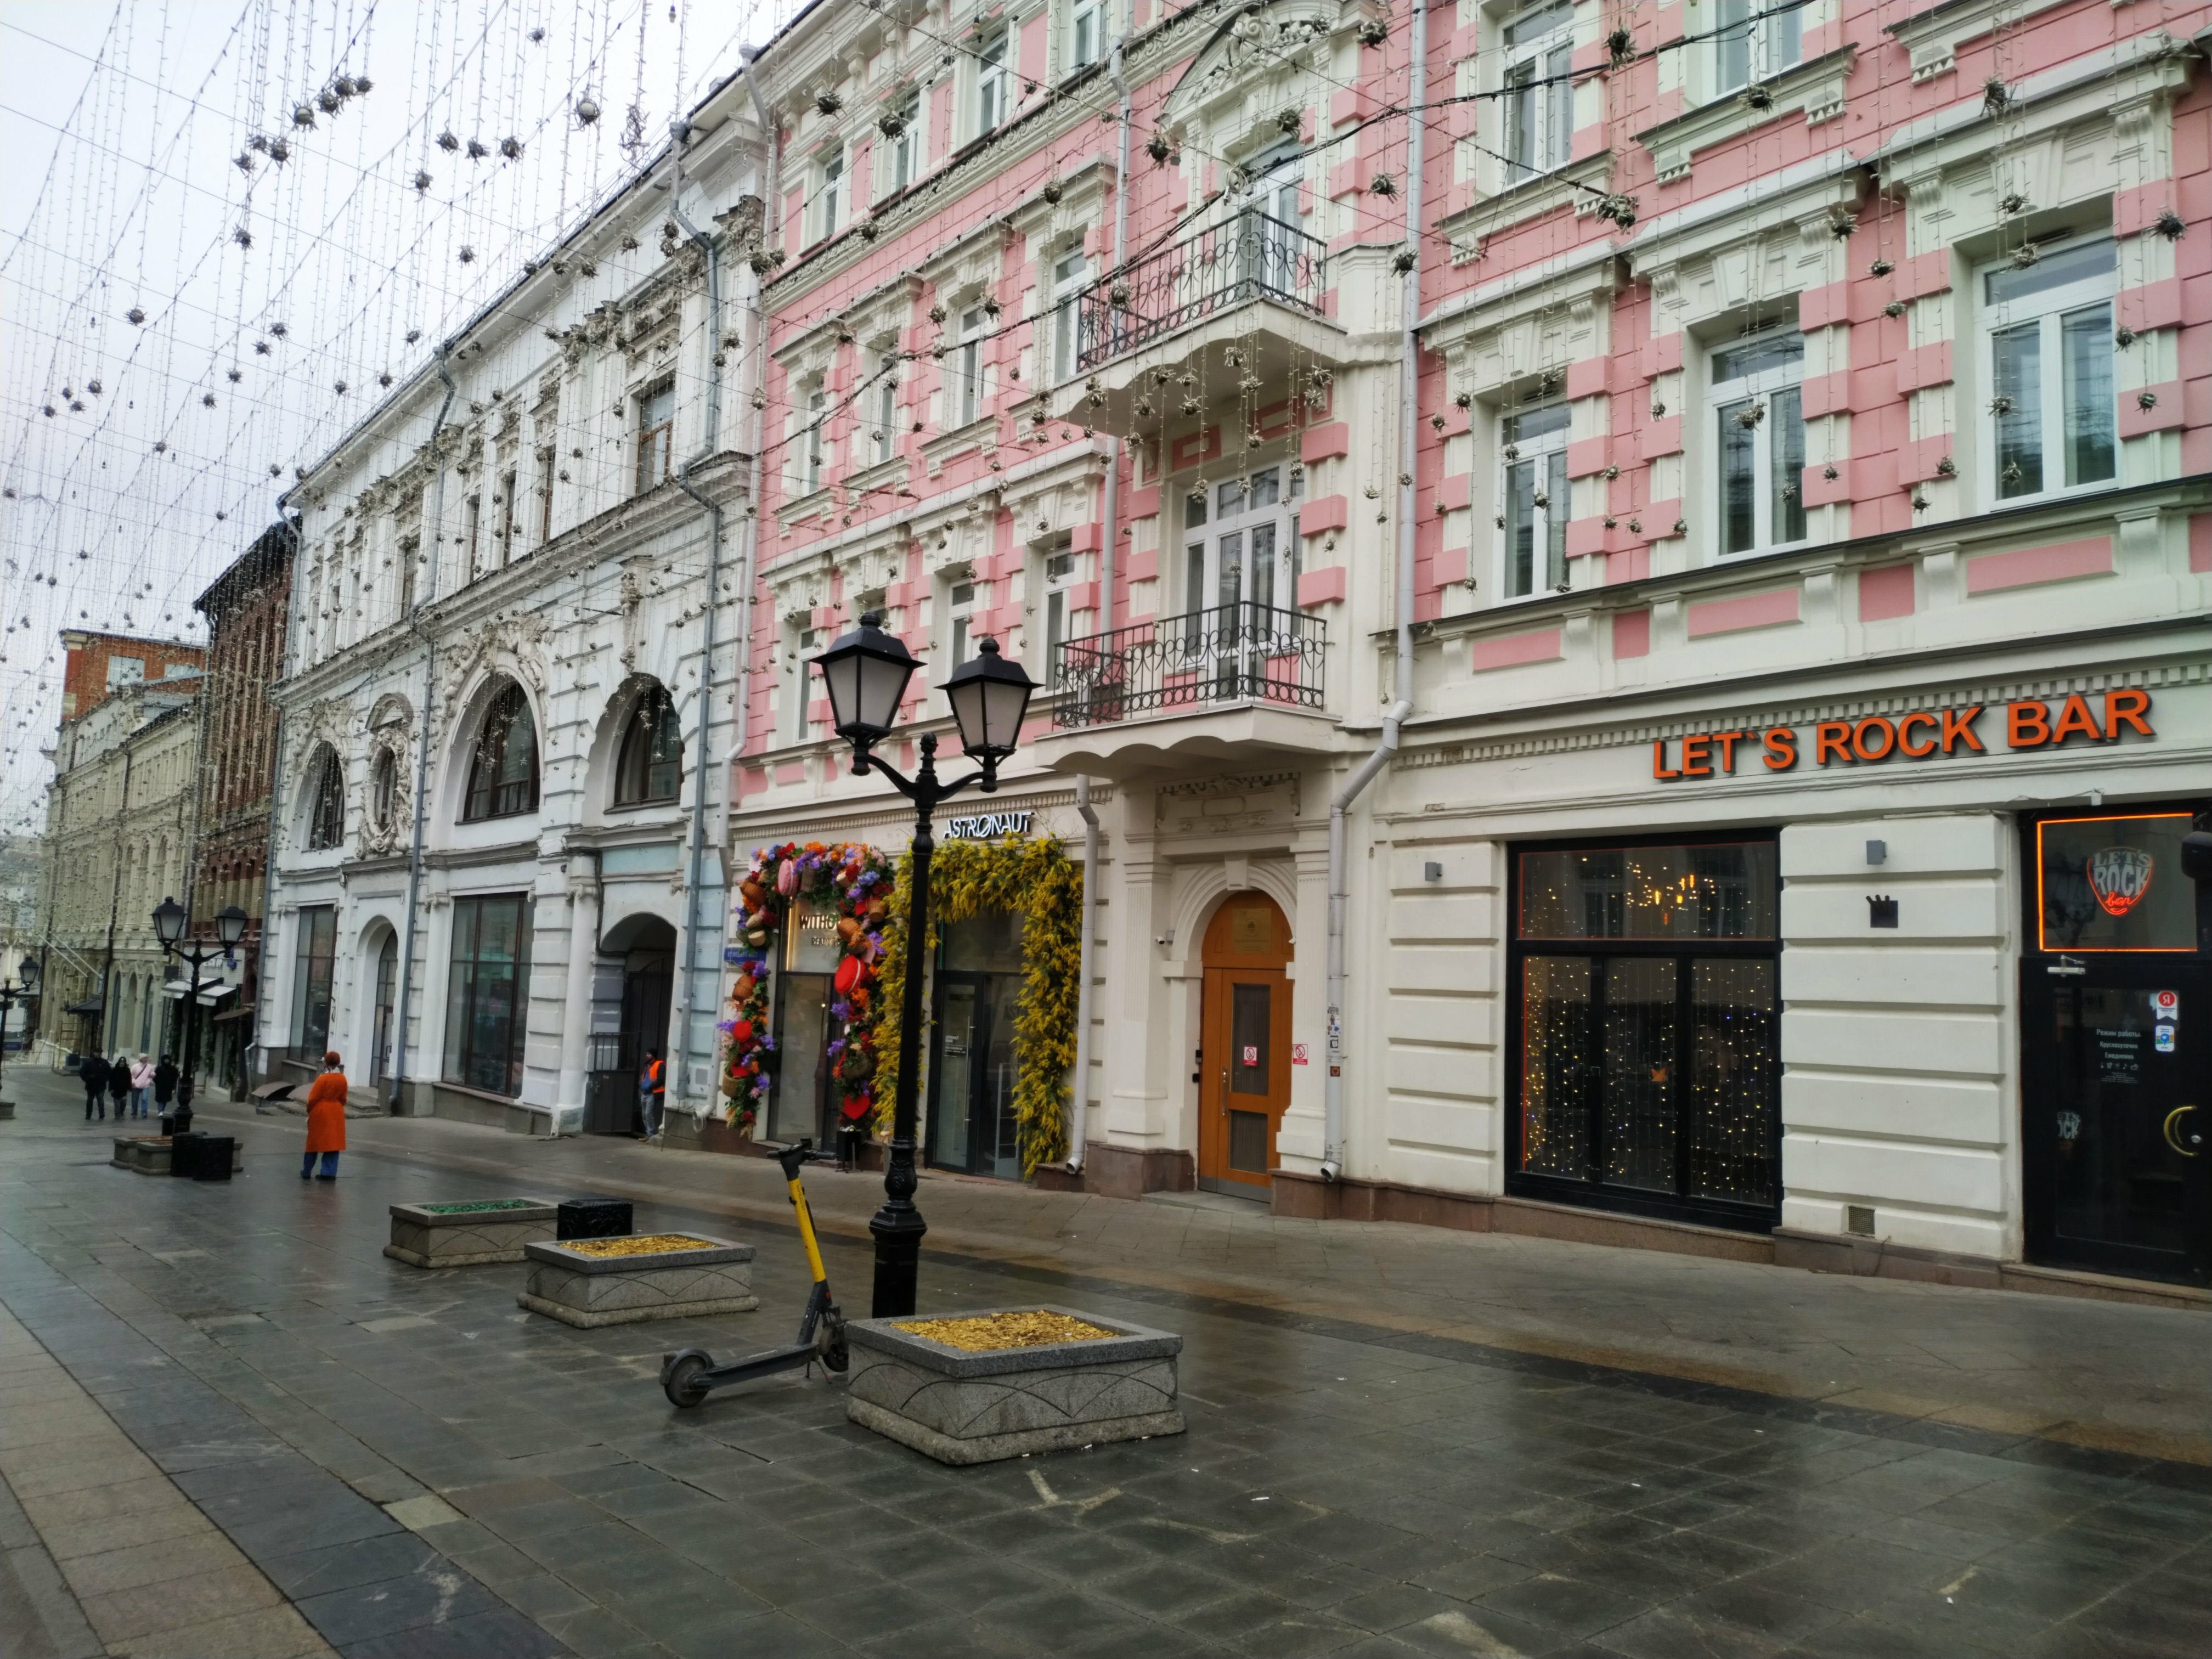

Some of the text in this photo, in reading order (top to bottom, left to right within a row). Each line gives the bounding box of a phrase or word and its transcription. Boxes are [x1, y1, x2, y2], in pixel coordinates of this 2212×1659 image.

[1816, 707, 1982, 764] ROCK
[2007, 690, 2153, 747] BAR
[2094, 864, 2149, 896] ROCK
